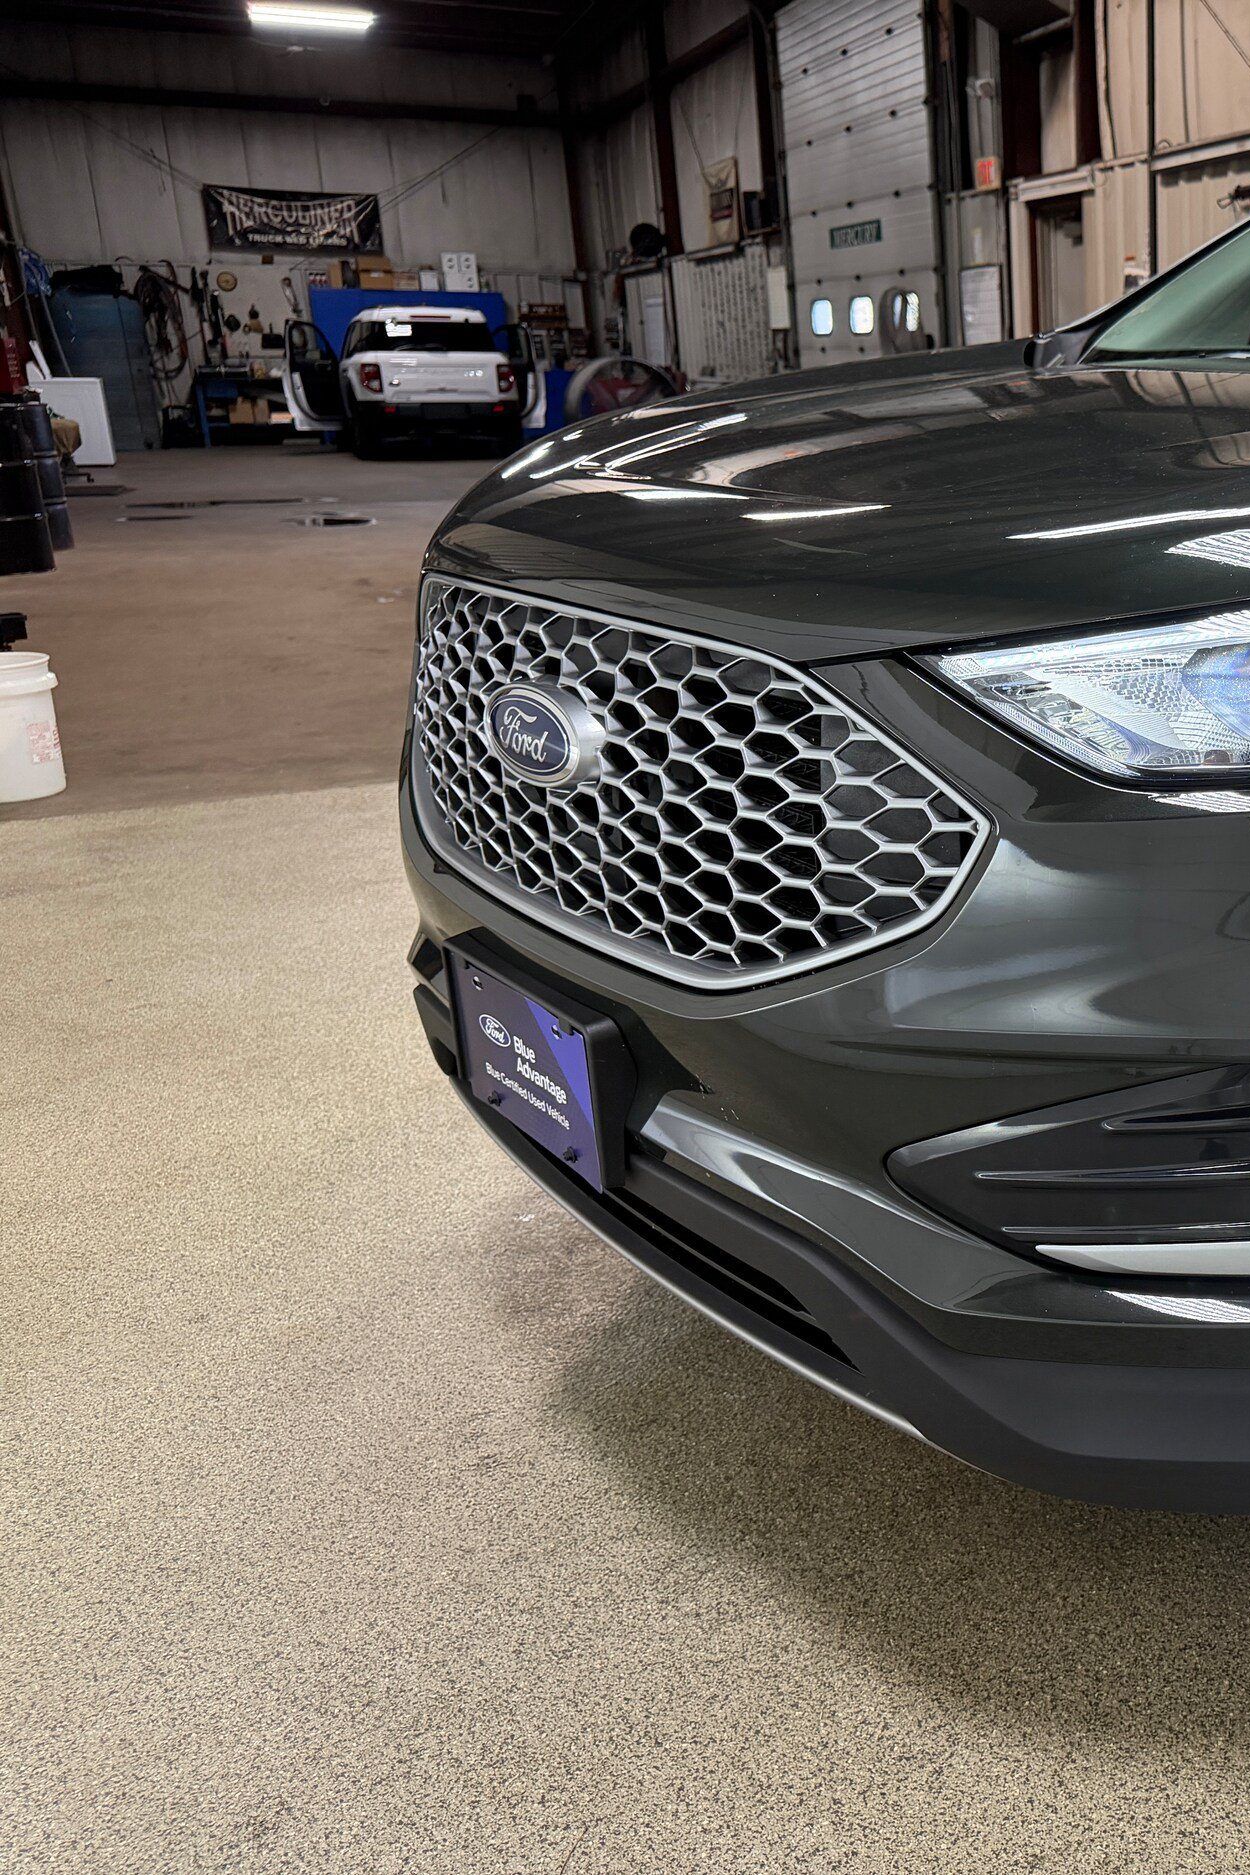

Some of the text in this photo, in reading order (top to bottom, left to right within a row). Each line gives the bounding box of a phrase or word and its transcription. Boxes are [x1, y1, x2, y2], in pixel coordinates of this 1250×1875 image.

[221, 188, 361, 245] HERCULINER
[499, 705, 549, 763] Ford
[485, 1018, 506, 1043] Ford
[513, 1036, 536, 1063] Blue
[485, 1062, 570, 1130] Blue Certified Used Vehicle
[516, 1057, 567, 1104] Advantage
